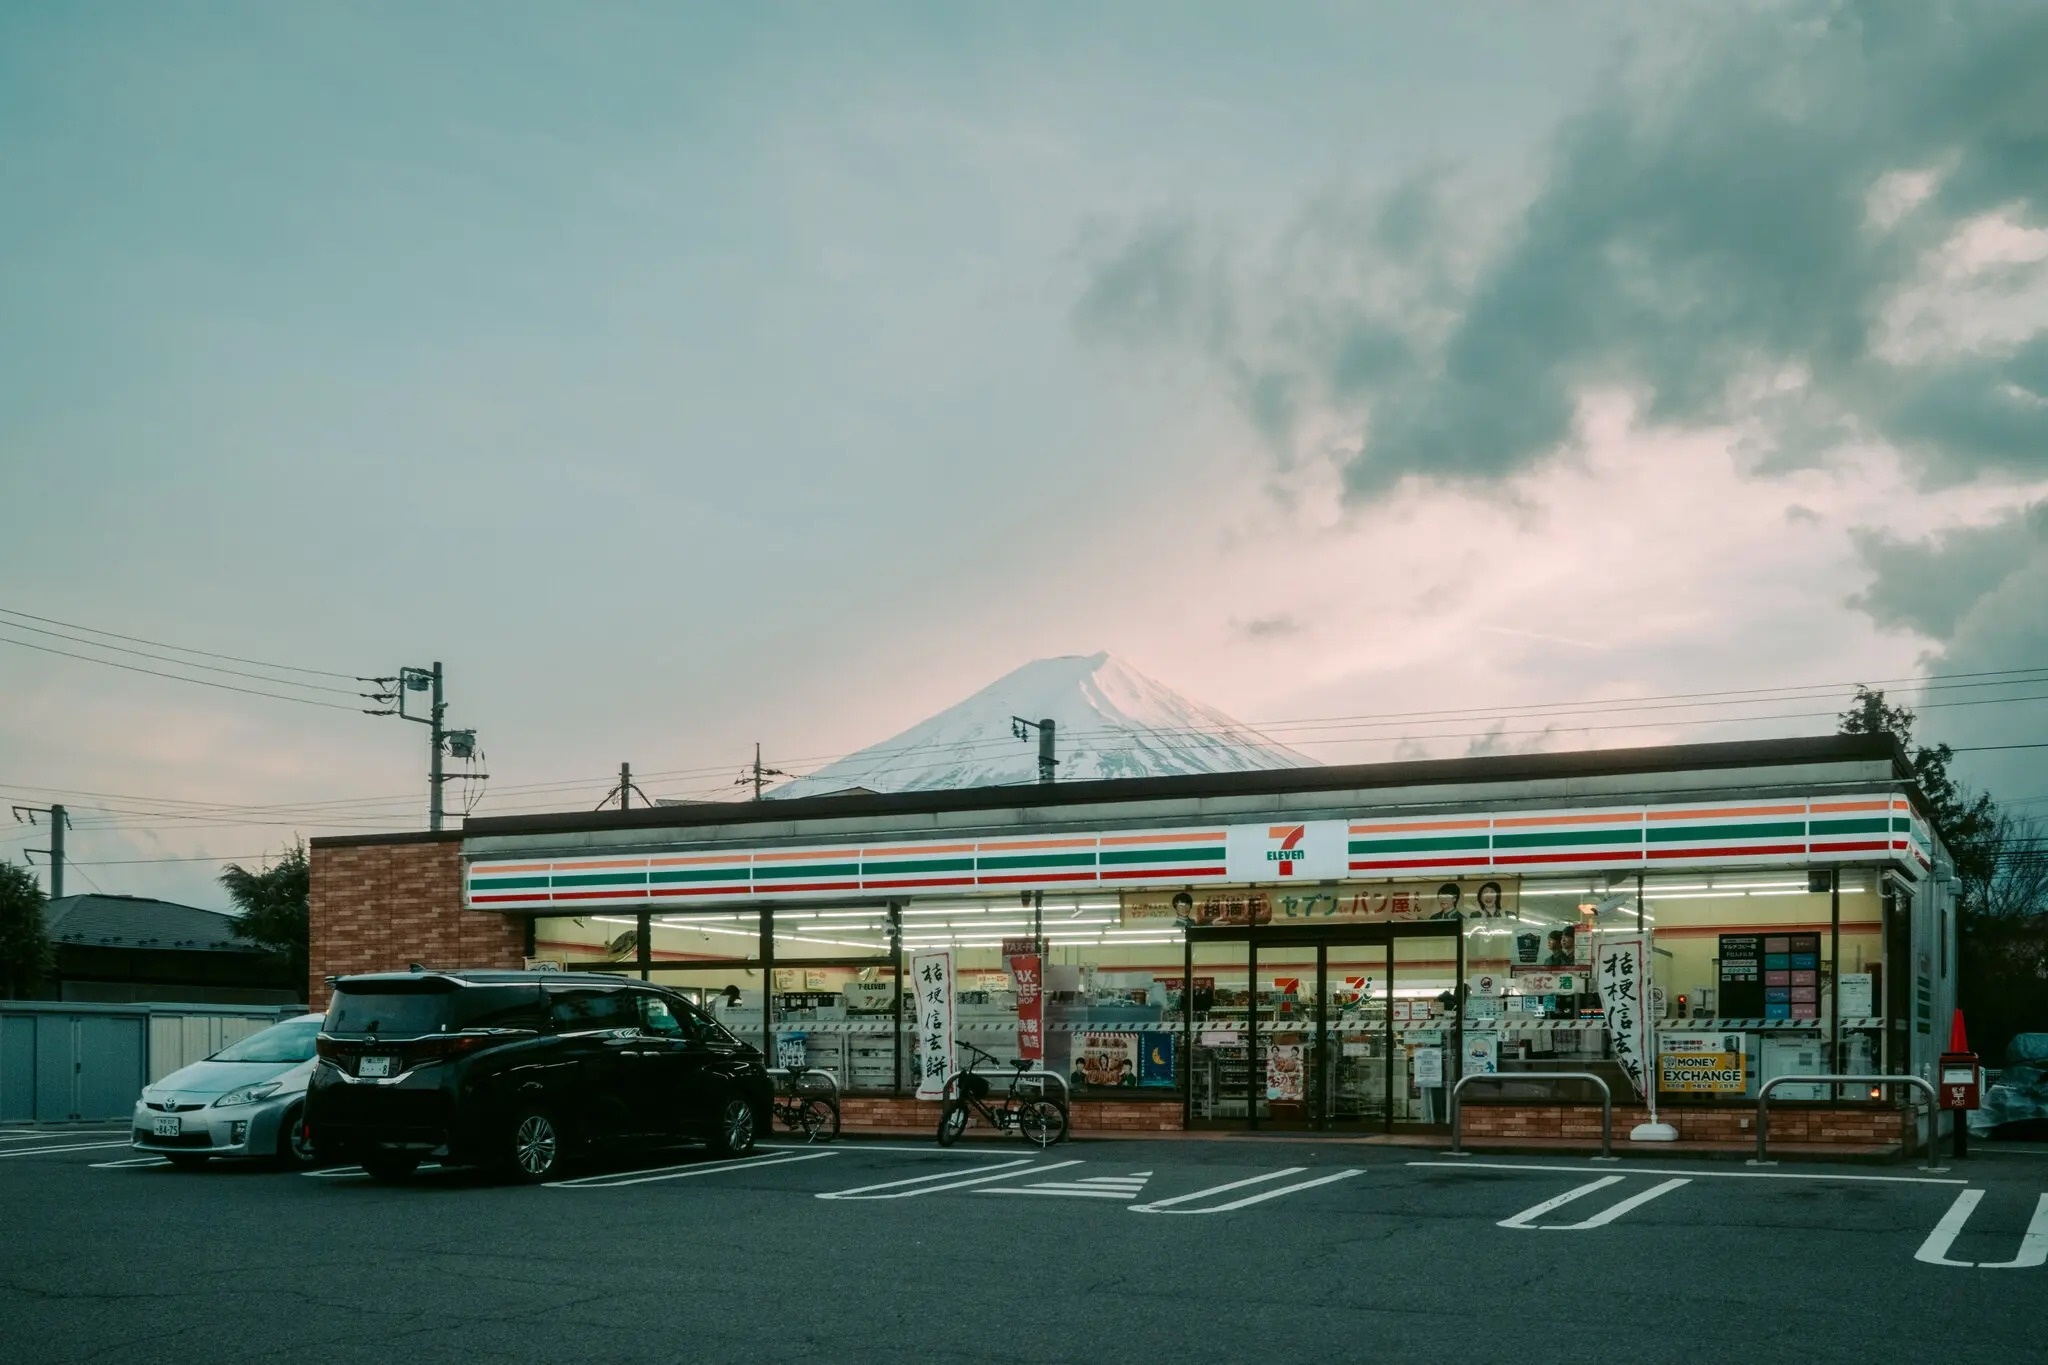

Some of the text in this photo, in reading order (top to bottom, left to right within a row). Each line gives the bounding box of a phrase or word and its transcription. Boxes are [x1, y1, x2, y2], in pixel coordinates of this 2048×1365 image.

[1523, 976, 1573, 989] たばこ 酒
[1678, 1058, 1717, 1067] MONEY
[1664, 1070, 1741, 1081] EXCHANGE
